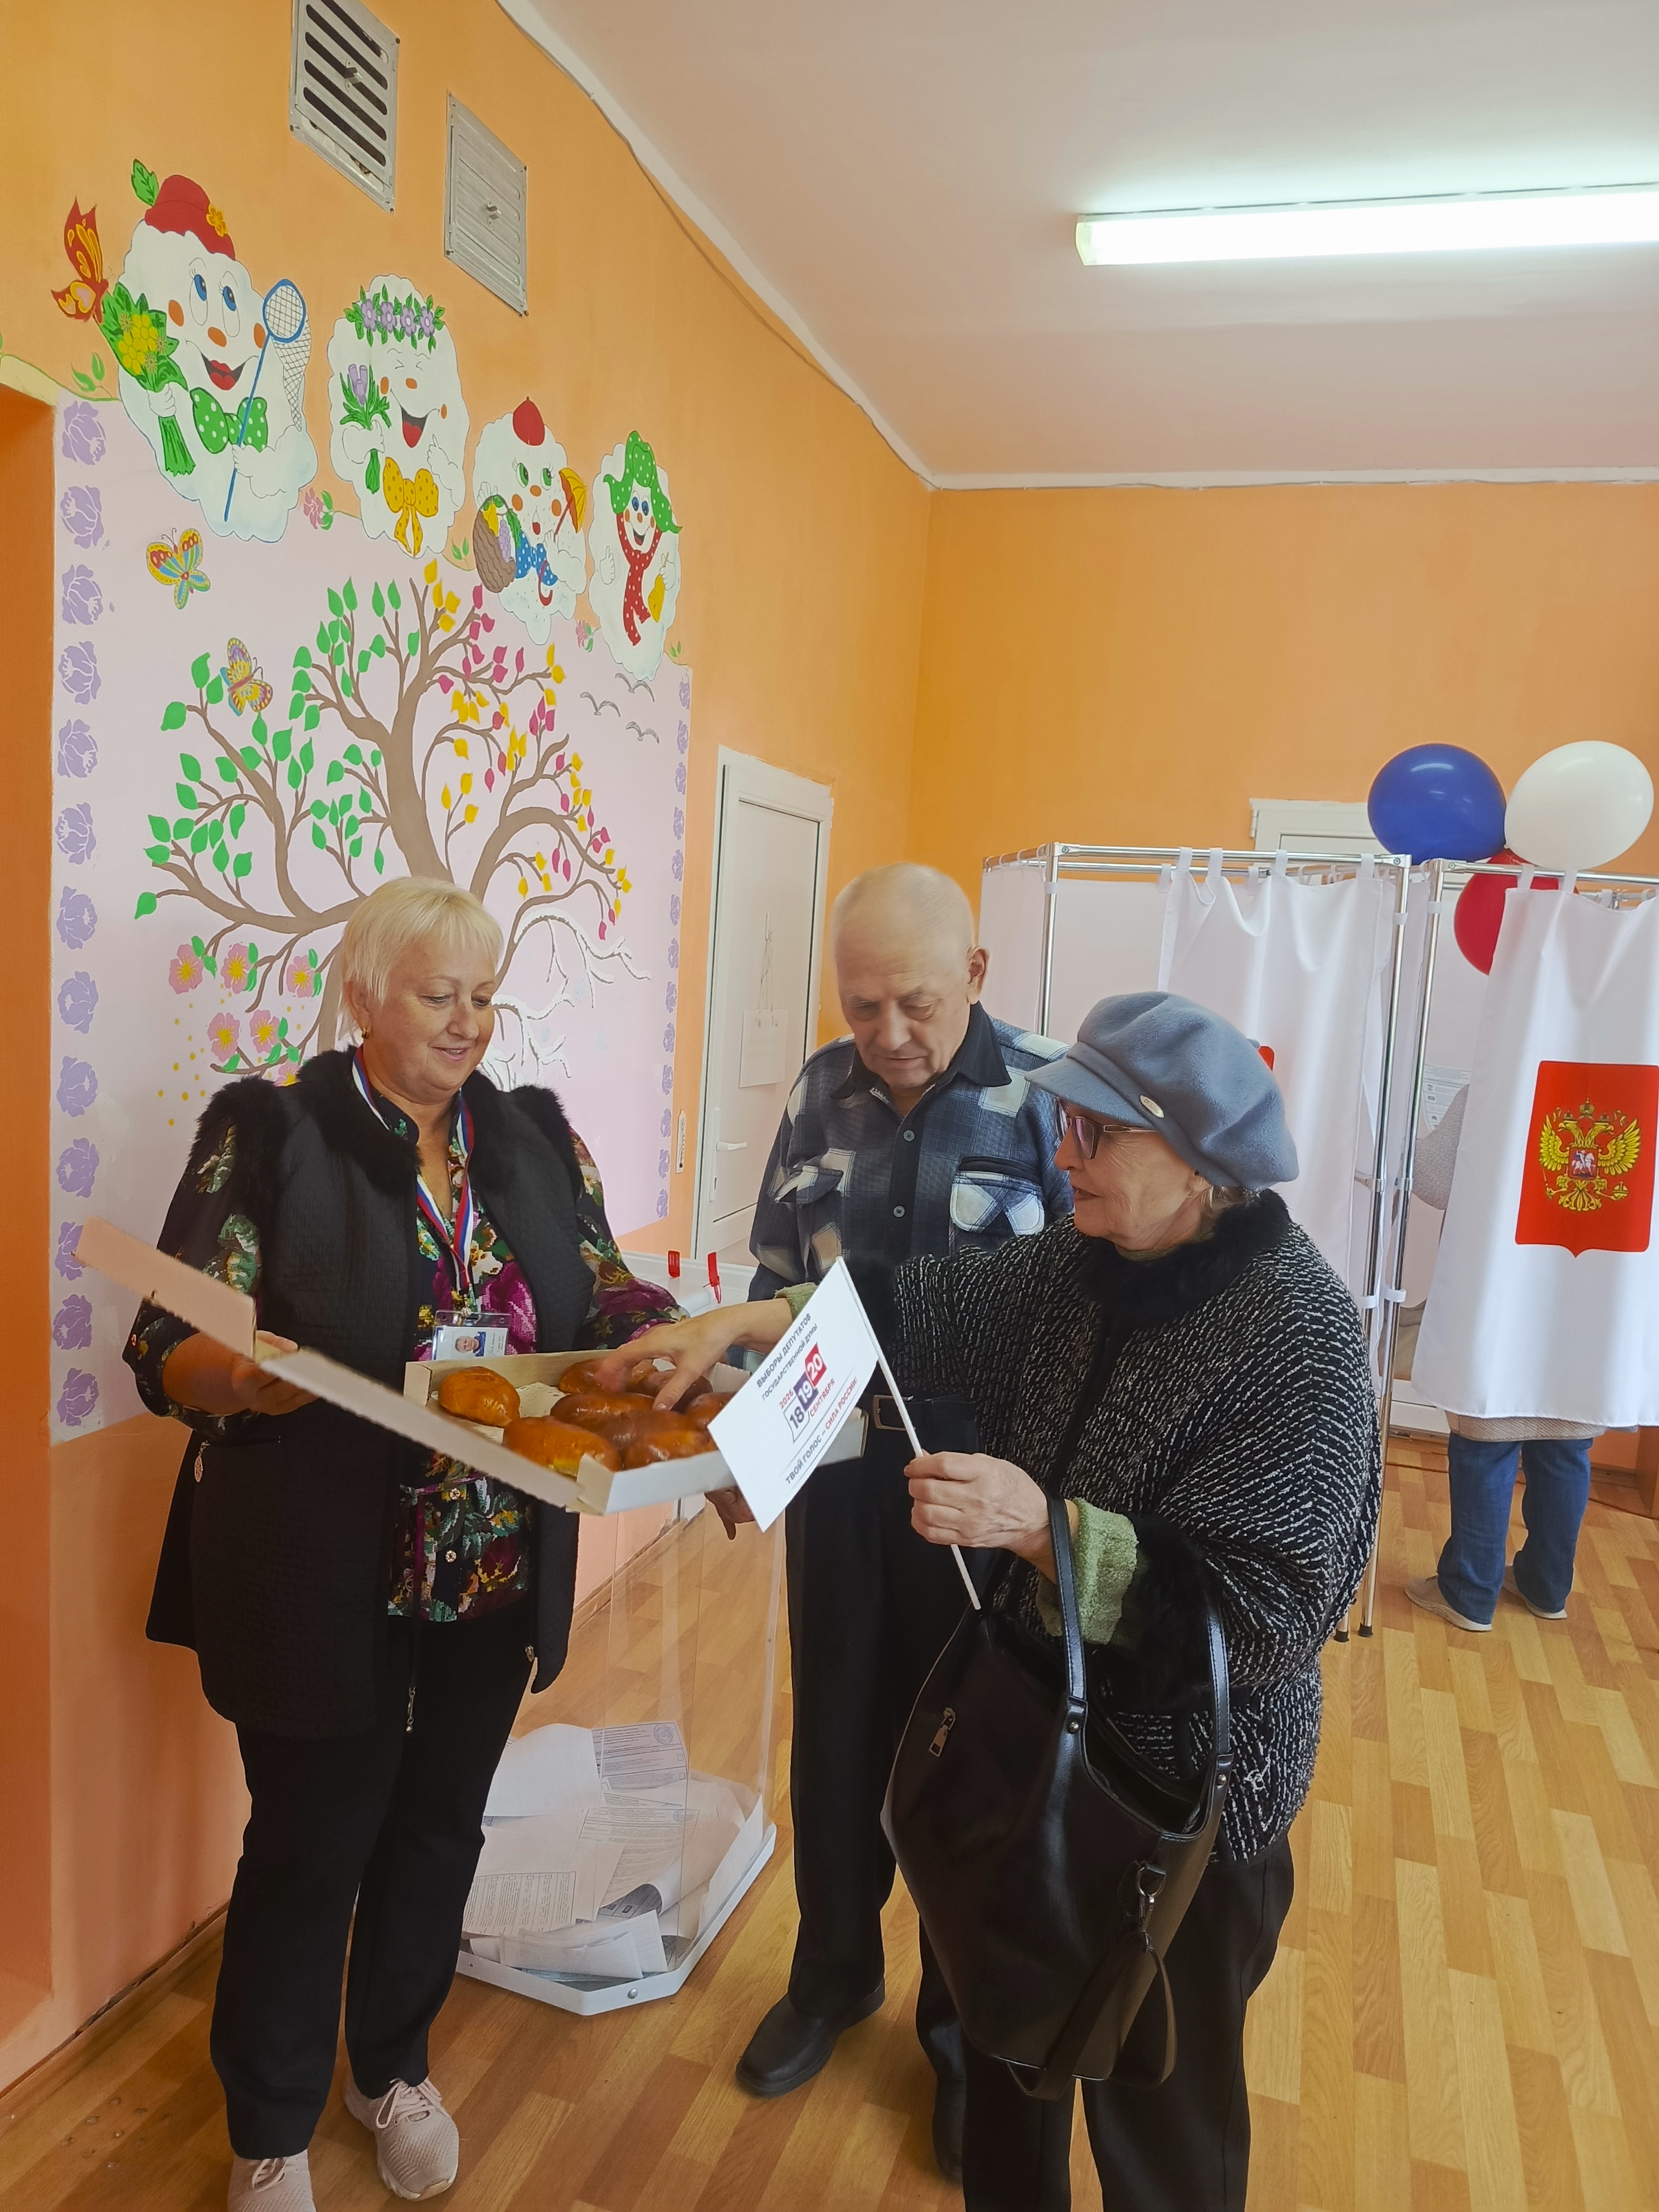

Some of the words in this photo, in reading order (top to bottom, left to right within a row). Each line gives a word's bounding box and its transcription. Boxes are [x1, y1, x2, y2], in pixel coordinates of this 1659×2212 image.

[756, 1352, 783, 1388] ВЫБОРЫ
[782, 1313, 812, 1357] ДЕПУТАТОВ
[761, 1340, 806, 1401] ГОСУДАРСТВЕННОЙ
[805, 1323, 818, 1344] ДУМЫ
[779, 1389, 794, 1409] 2026
[789, 1406, 805, 1429] 18
[798, 1380, 813, 1404] 19
[807, 1353, 823, 1381] 20
[809, 1377, 835, 1417] СЕНТЯБРЯ
[785, 1458, 804, 1484] ТВОЙ
[803, 1435, 822, 1463] ГОЛОС
[825, 1408, 840, 1430] СИЛА
[838, 1376, 858, 1409] РОССИИ!
